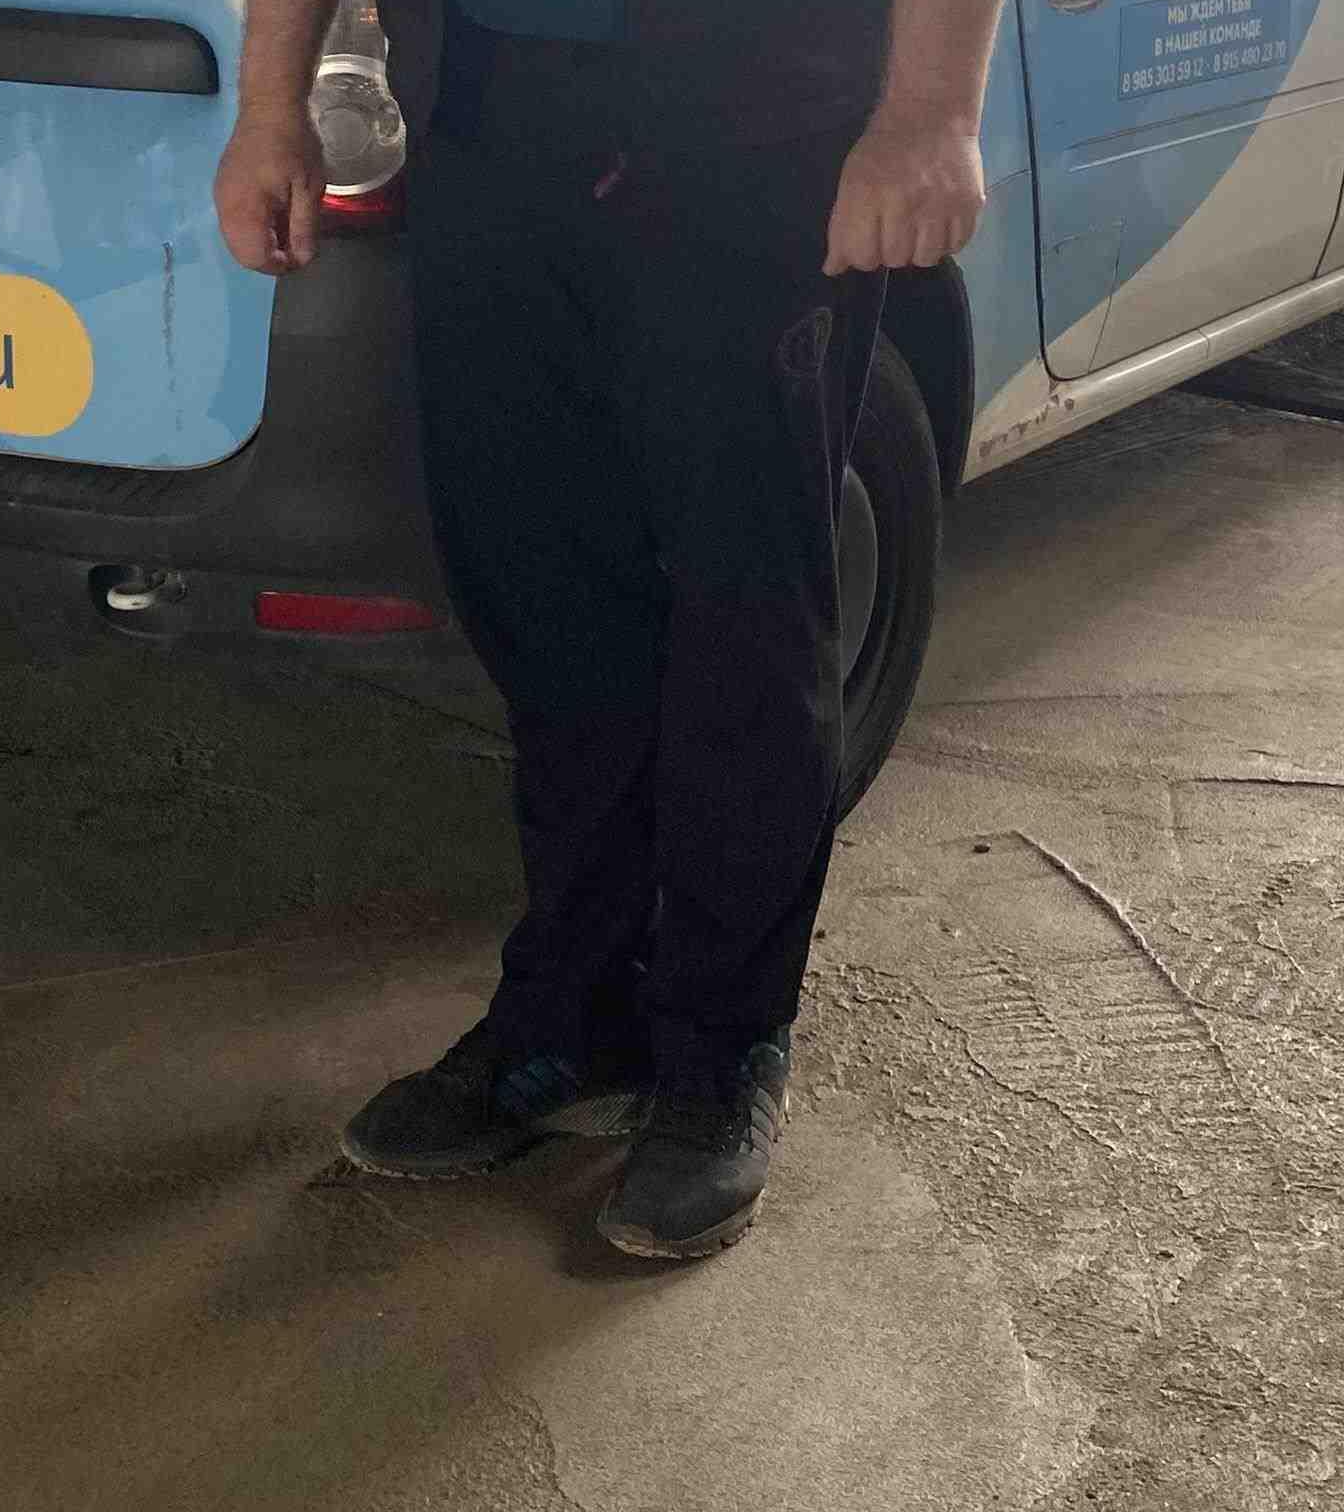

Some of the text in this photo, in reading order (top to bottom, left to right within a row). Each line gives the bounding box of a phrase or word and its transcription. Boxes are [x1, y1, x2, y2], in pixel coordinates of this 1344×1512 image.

[1167, 6, 1188, 25] МЫ
[1154, 17, 1263, 57] В НАШЕЙ КОМАНДЕ
[1122, 72, 1131, 93] 8
